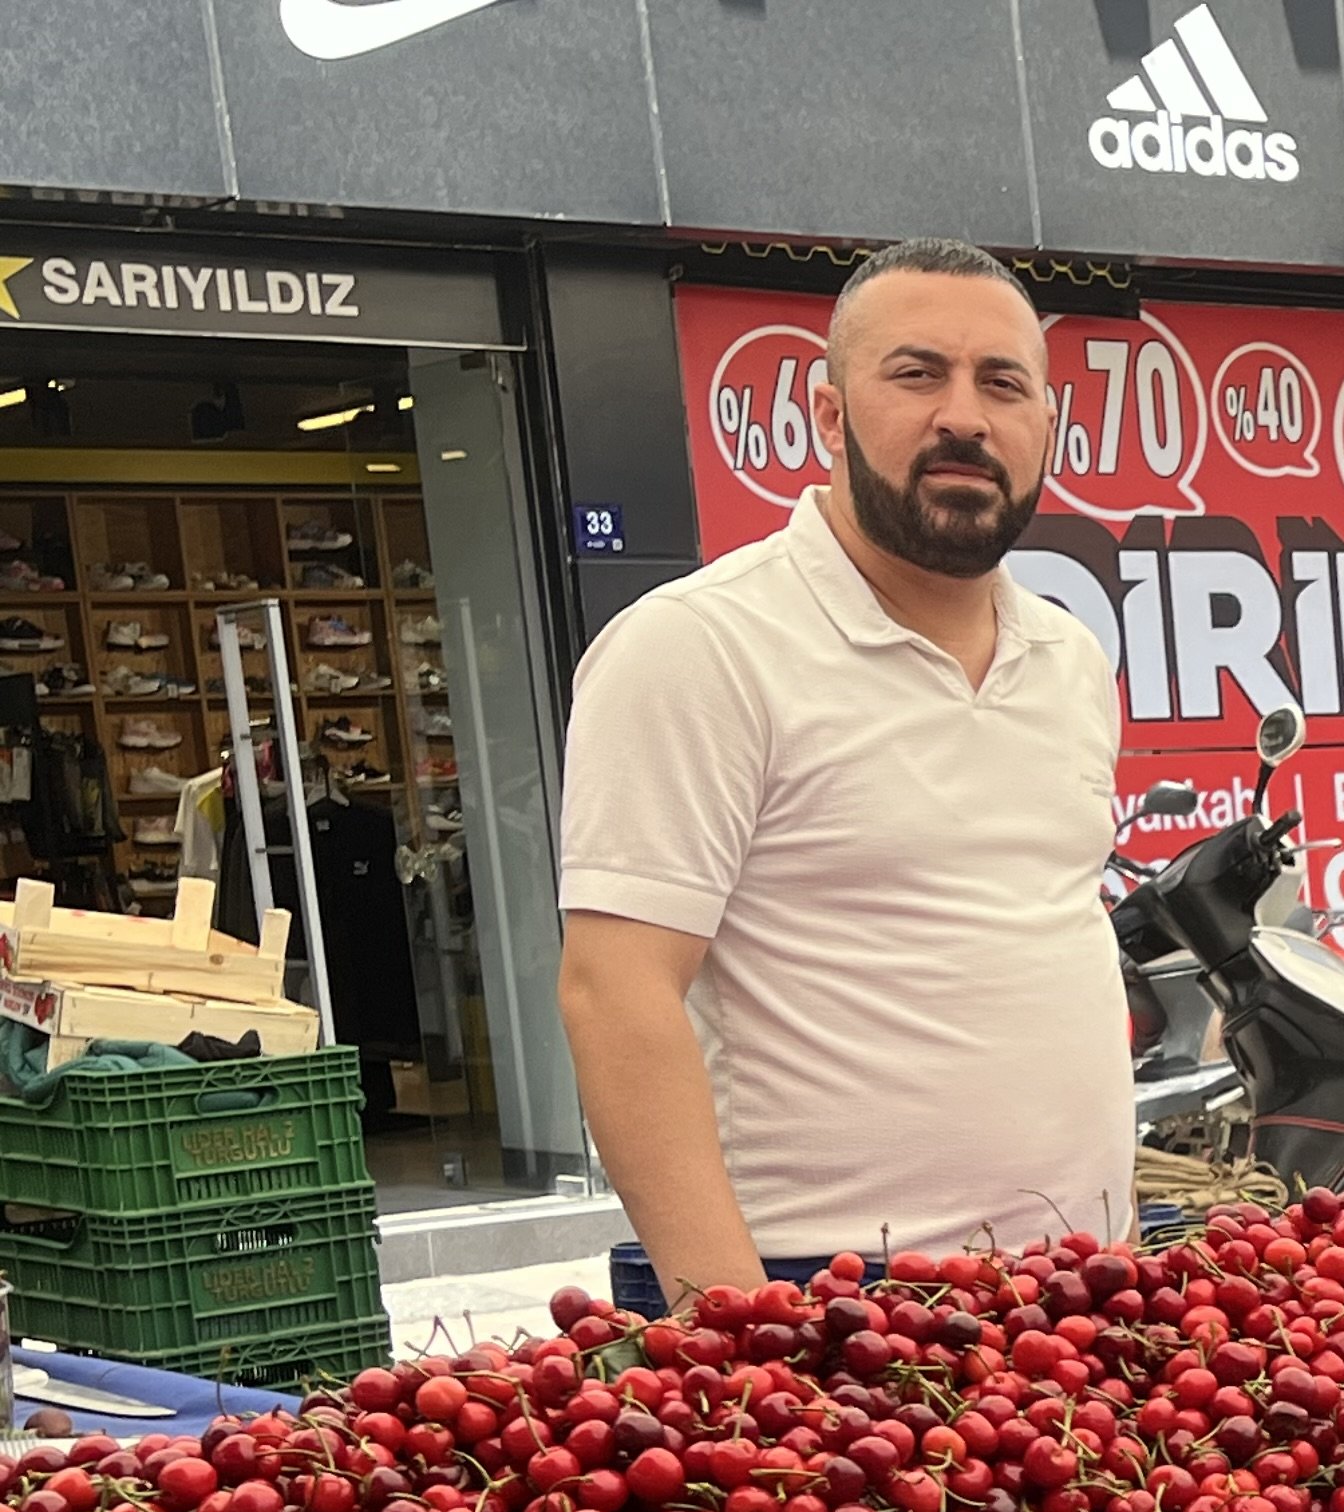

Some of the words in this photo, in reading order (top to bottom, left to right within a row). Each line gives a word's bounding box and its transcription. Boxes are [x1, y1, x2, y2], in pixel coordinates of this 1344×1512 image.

[1088, 109, 1299, 181] adidas
[41, 256, 359, 317] SARIYILDIZ
[1225, 367, 1303, 443] %40
[586, 511, 613, 535] 33
